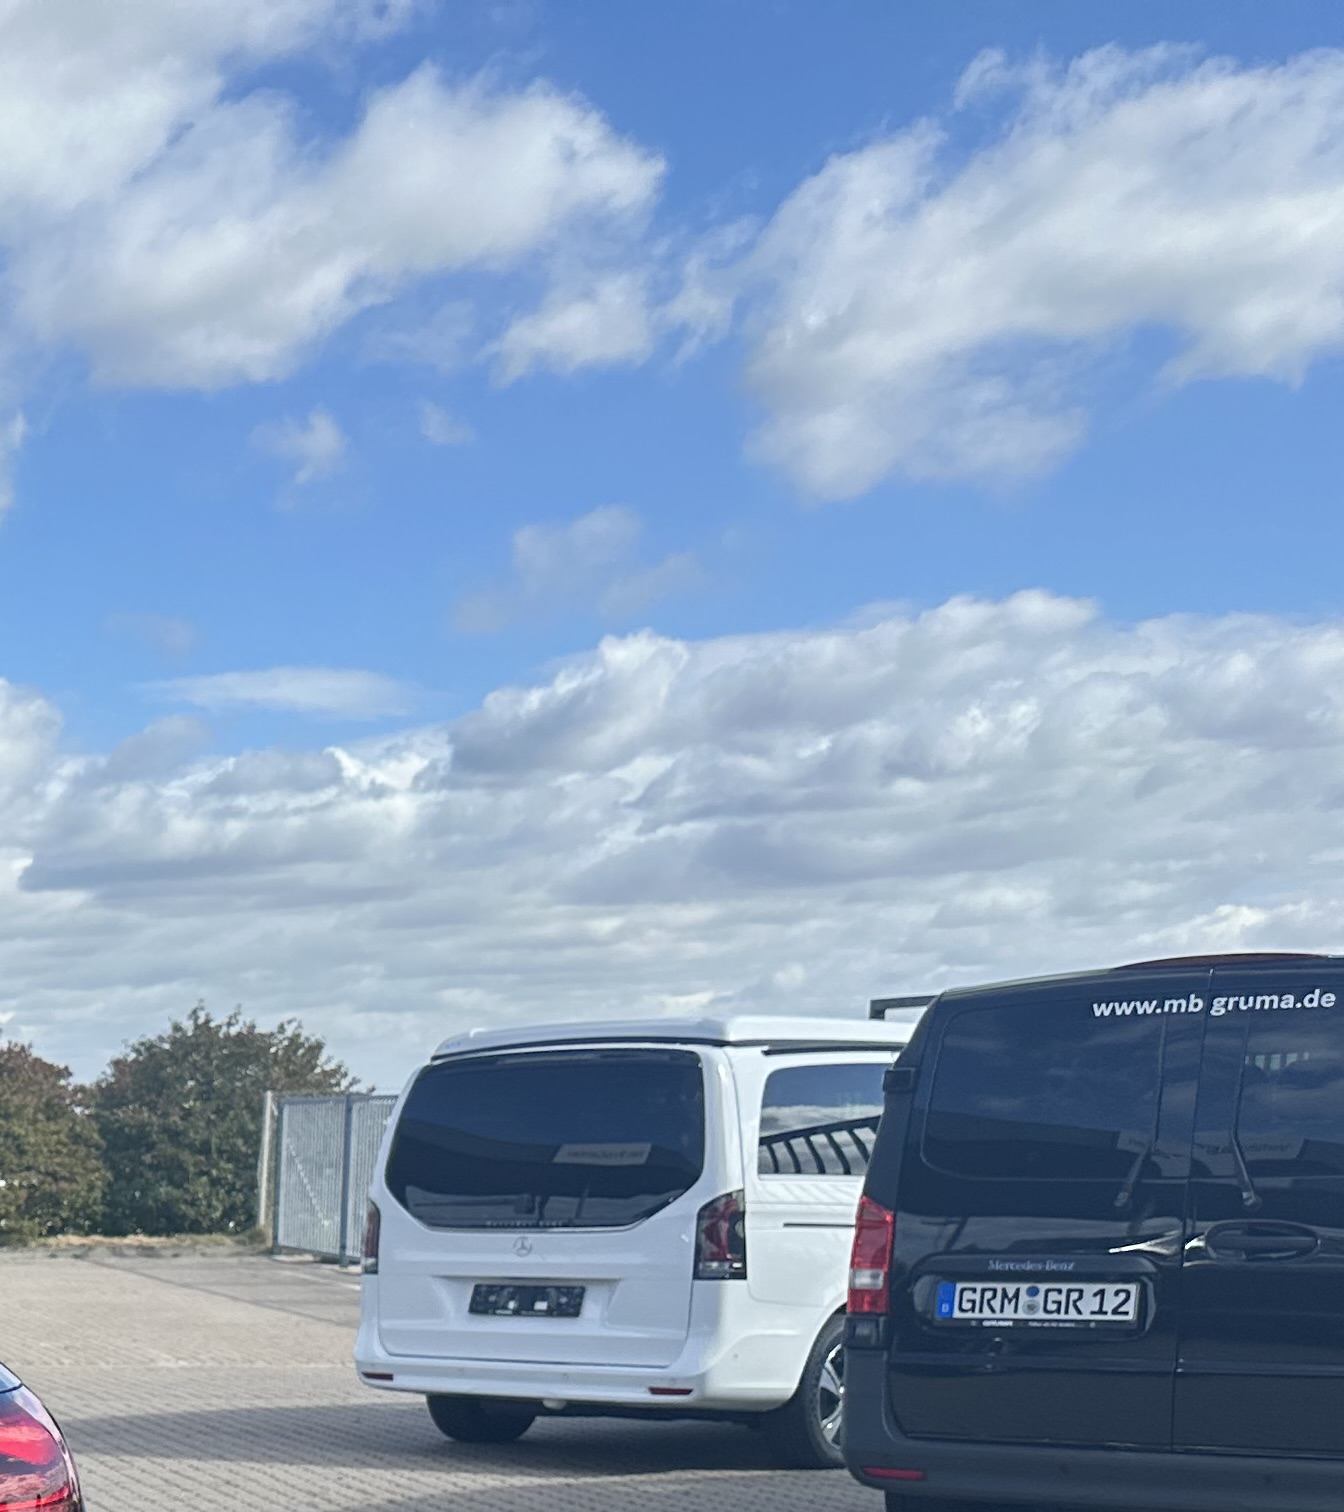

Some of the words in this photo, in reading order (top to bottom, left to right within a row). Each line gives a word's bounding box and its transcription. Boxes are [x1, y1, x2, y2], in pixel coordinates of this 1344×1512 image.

[987, 1260, 1076, 1271] Mercedes-Benz
[957, 1286, 1021, 1314] GRM
[1042, 1287, 1084, 1315] GR
[1090, 1288, 1131, 1316] 12
